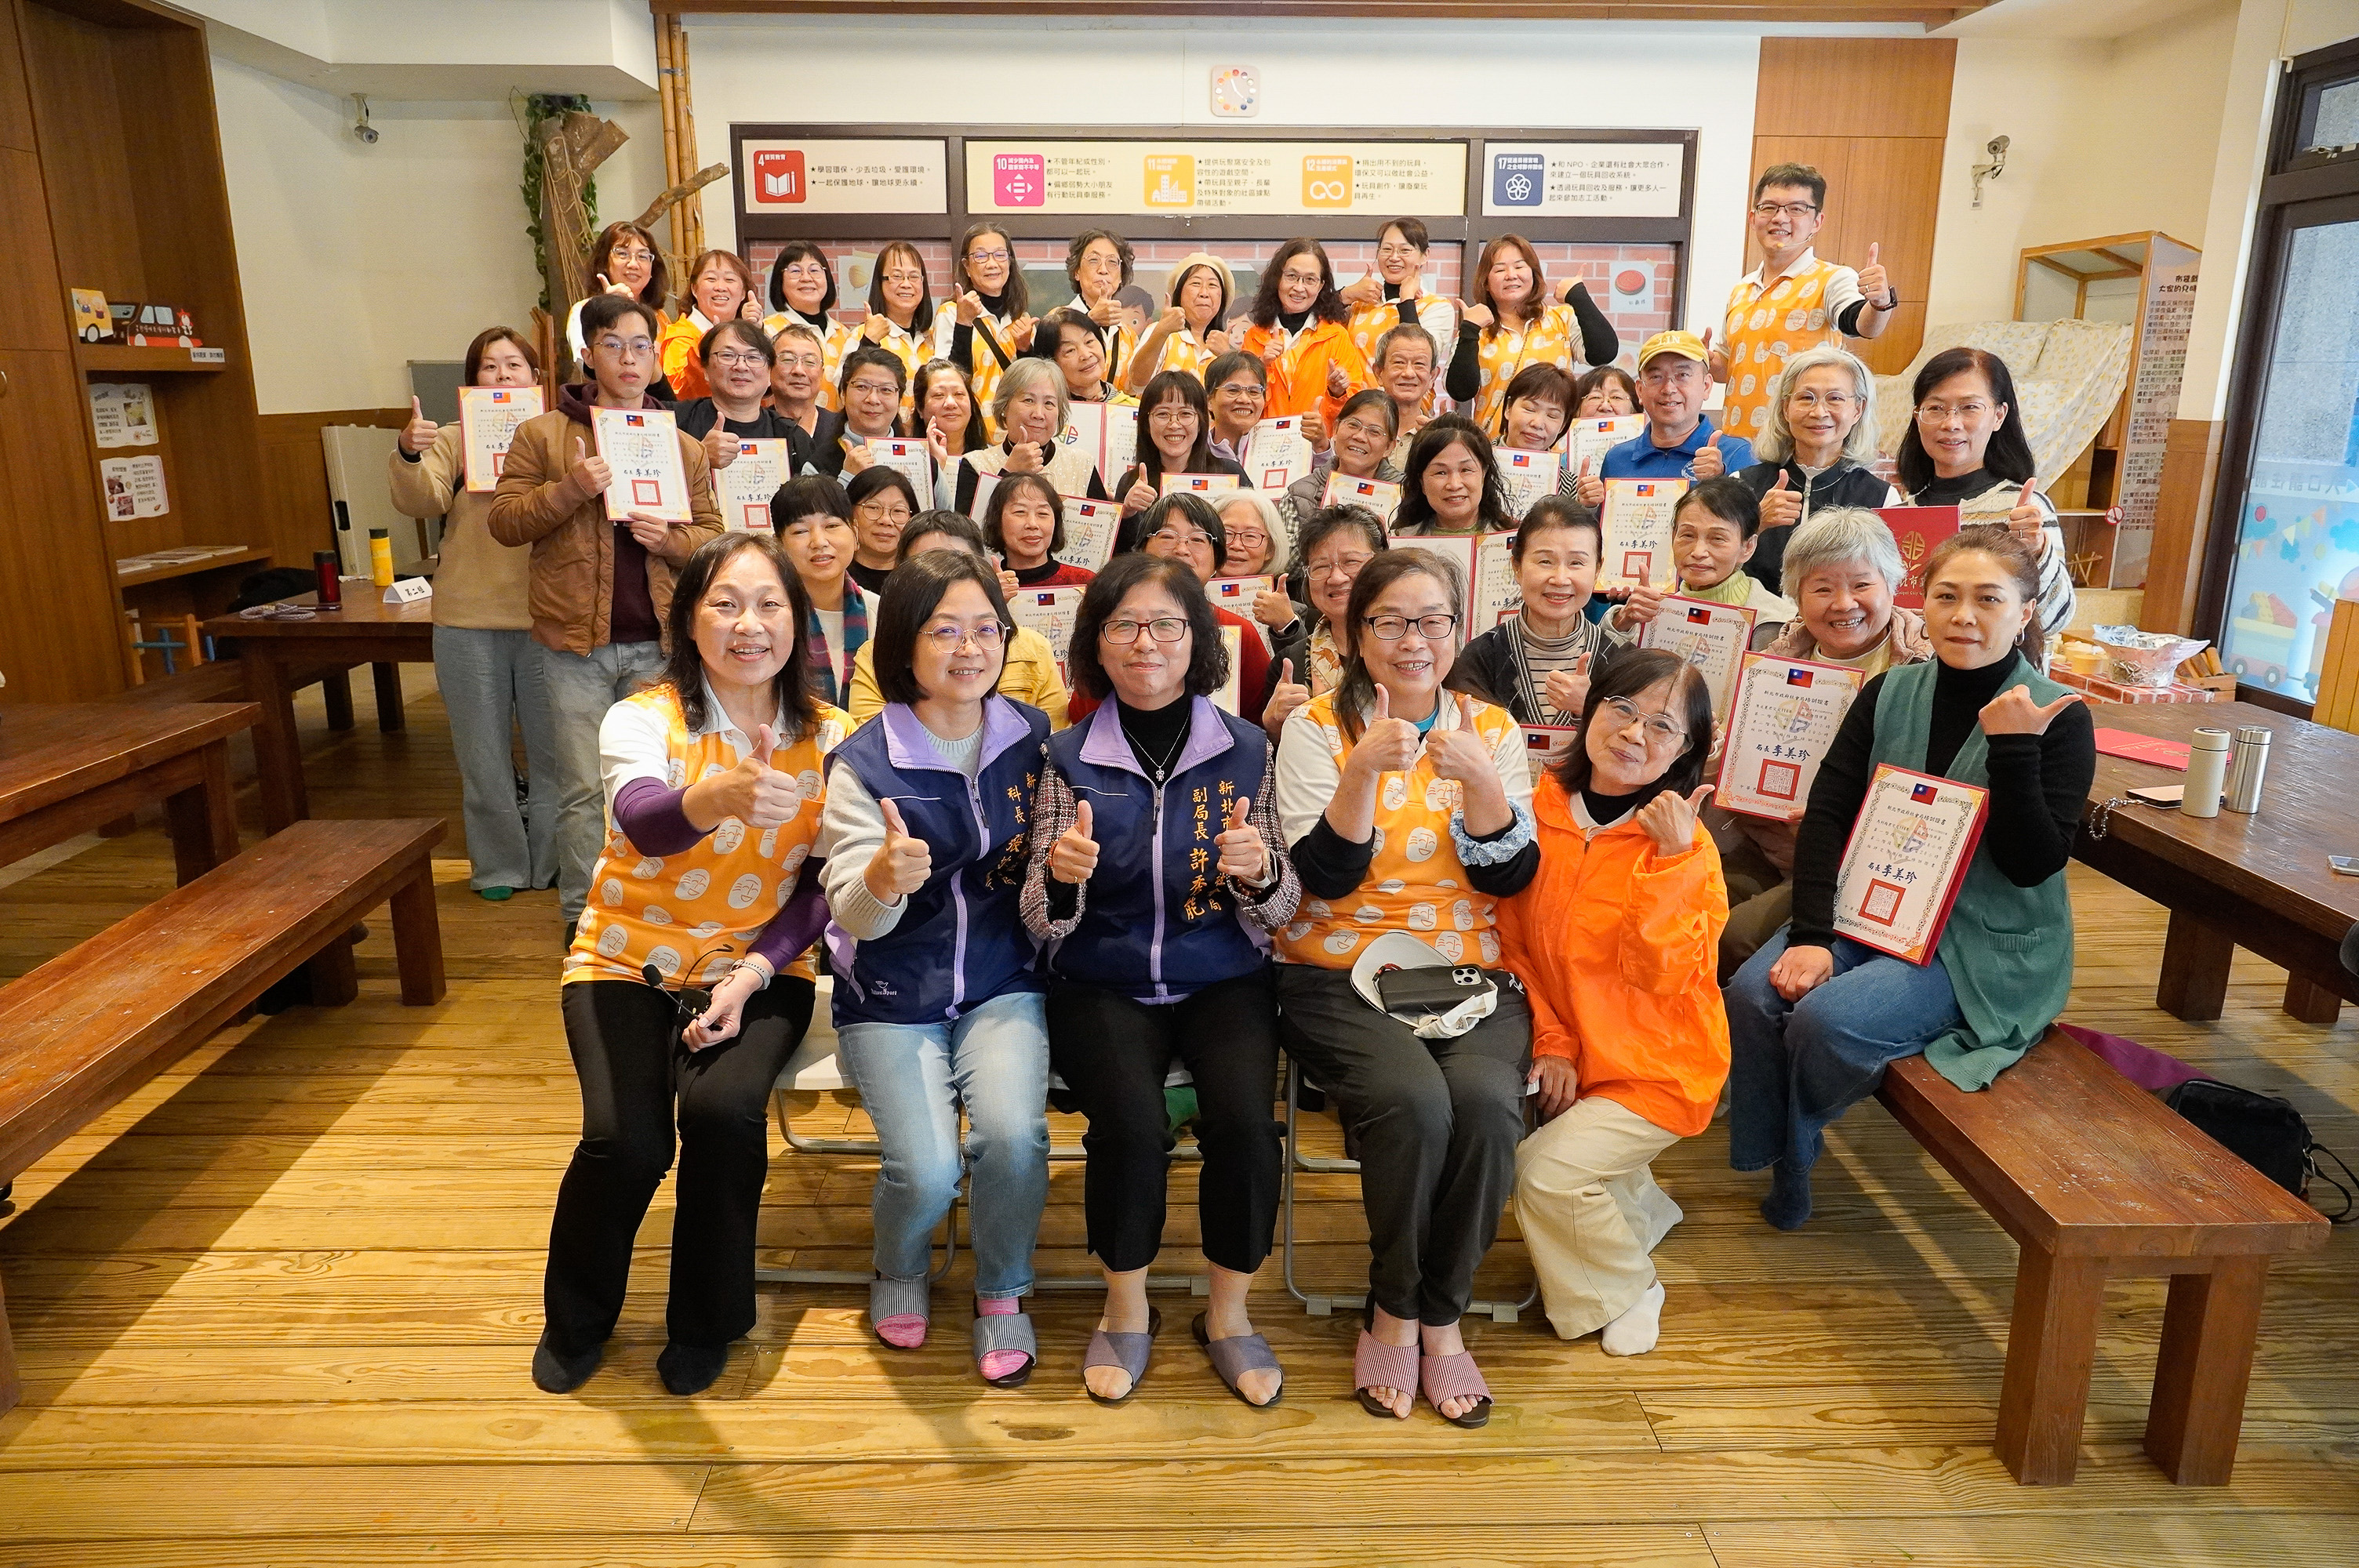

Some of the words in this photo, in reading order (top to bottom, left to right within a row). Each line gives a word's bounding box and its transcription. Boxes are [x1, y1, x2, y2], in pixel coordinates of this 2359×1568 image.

[758, 154, 765, 166] 4
[997, 158, 1008, 170] 10
[1147, 158, 1156, 170] 11
[1307, 159, 1315, 171] 12
[1498, 158, 1507, 169] 17
[1006, 785, 1026, 824] 科長
[1192, 786, 1209, 841] 副局長
[1868, 862, 1917, 884] 局長李美珍
